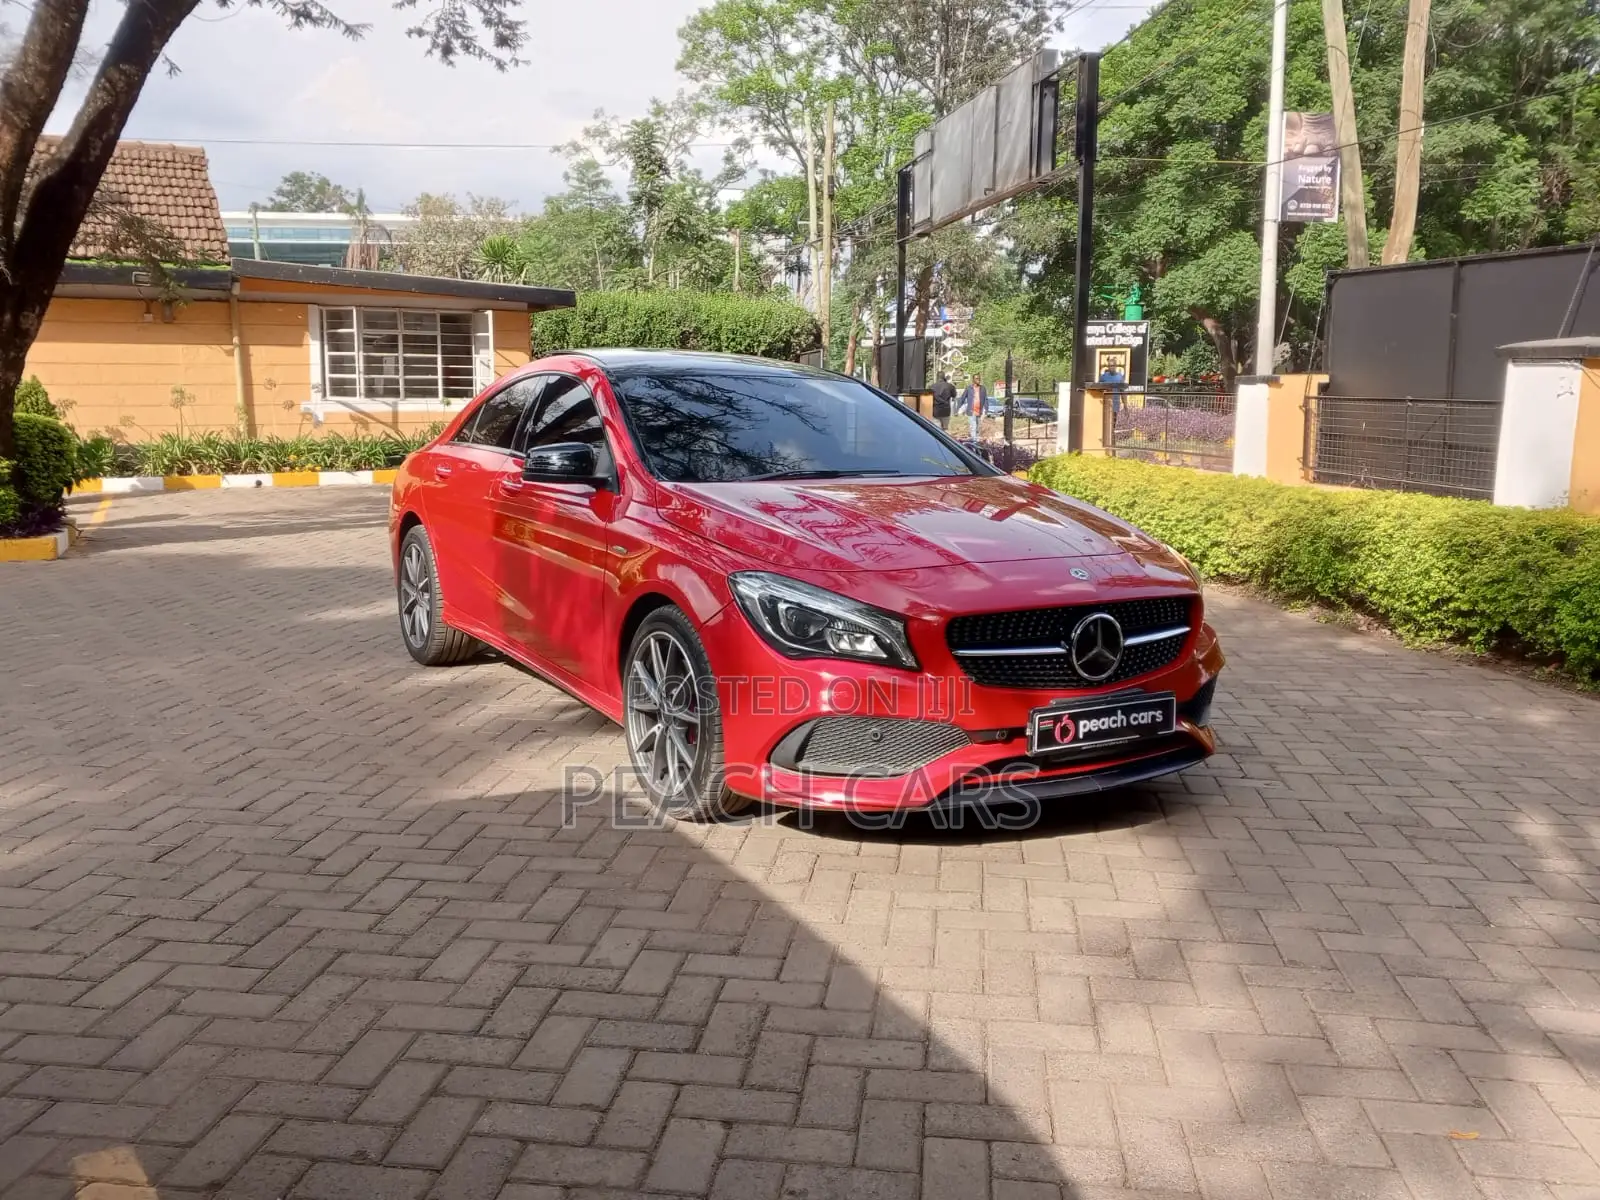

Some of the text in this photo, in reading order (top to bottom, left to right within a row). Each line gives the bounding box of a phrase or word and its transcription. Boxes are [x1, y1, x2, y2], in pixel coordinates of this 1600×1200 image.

[1298, 175, 1332, 185] Nature
[1086, 322, 1148, 336] enya College of
[1115, 335, 1143, 347] Design
[1079, 709, 1163, 739] peach cars
